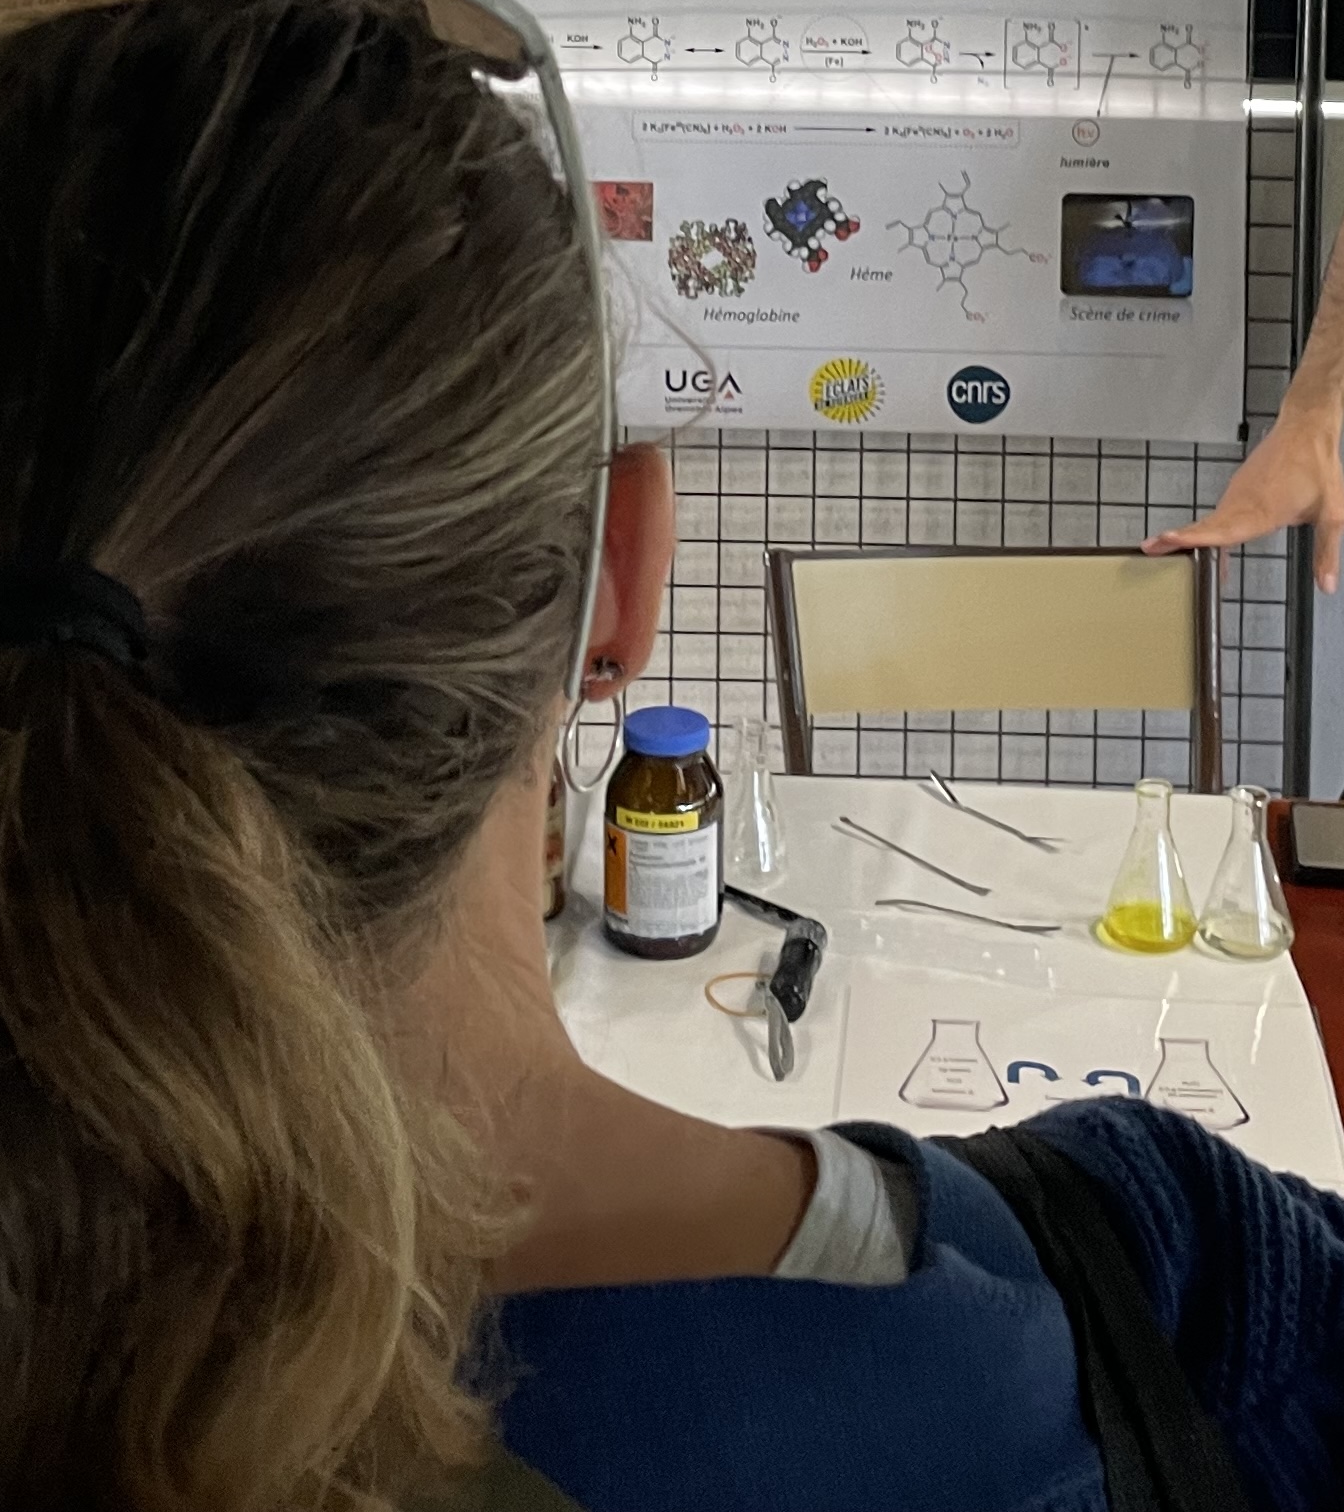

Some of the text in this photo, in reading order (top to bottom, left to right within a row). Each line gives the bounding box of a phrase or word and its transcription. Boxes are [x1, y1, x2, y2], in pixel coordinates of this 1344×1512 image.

[704, 309, 799, 323] Hémoglobine
[1070, 307, 1180, 322] Scène de crime
[665, 370, 742, 394] UGA
[952, 381, 1006, 404] cnrs
